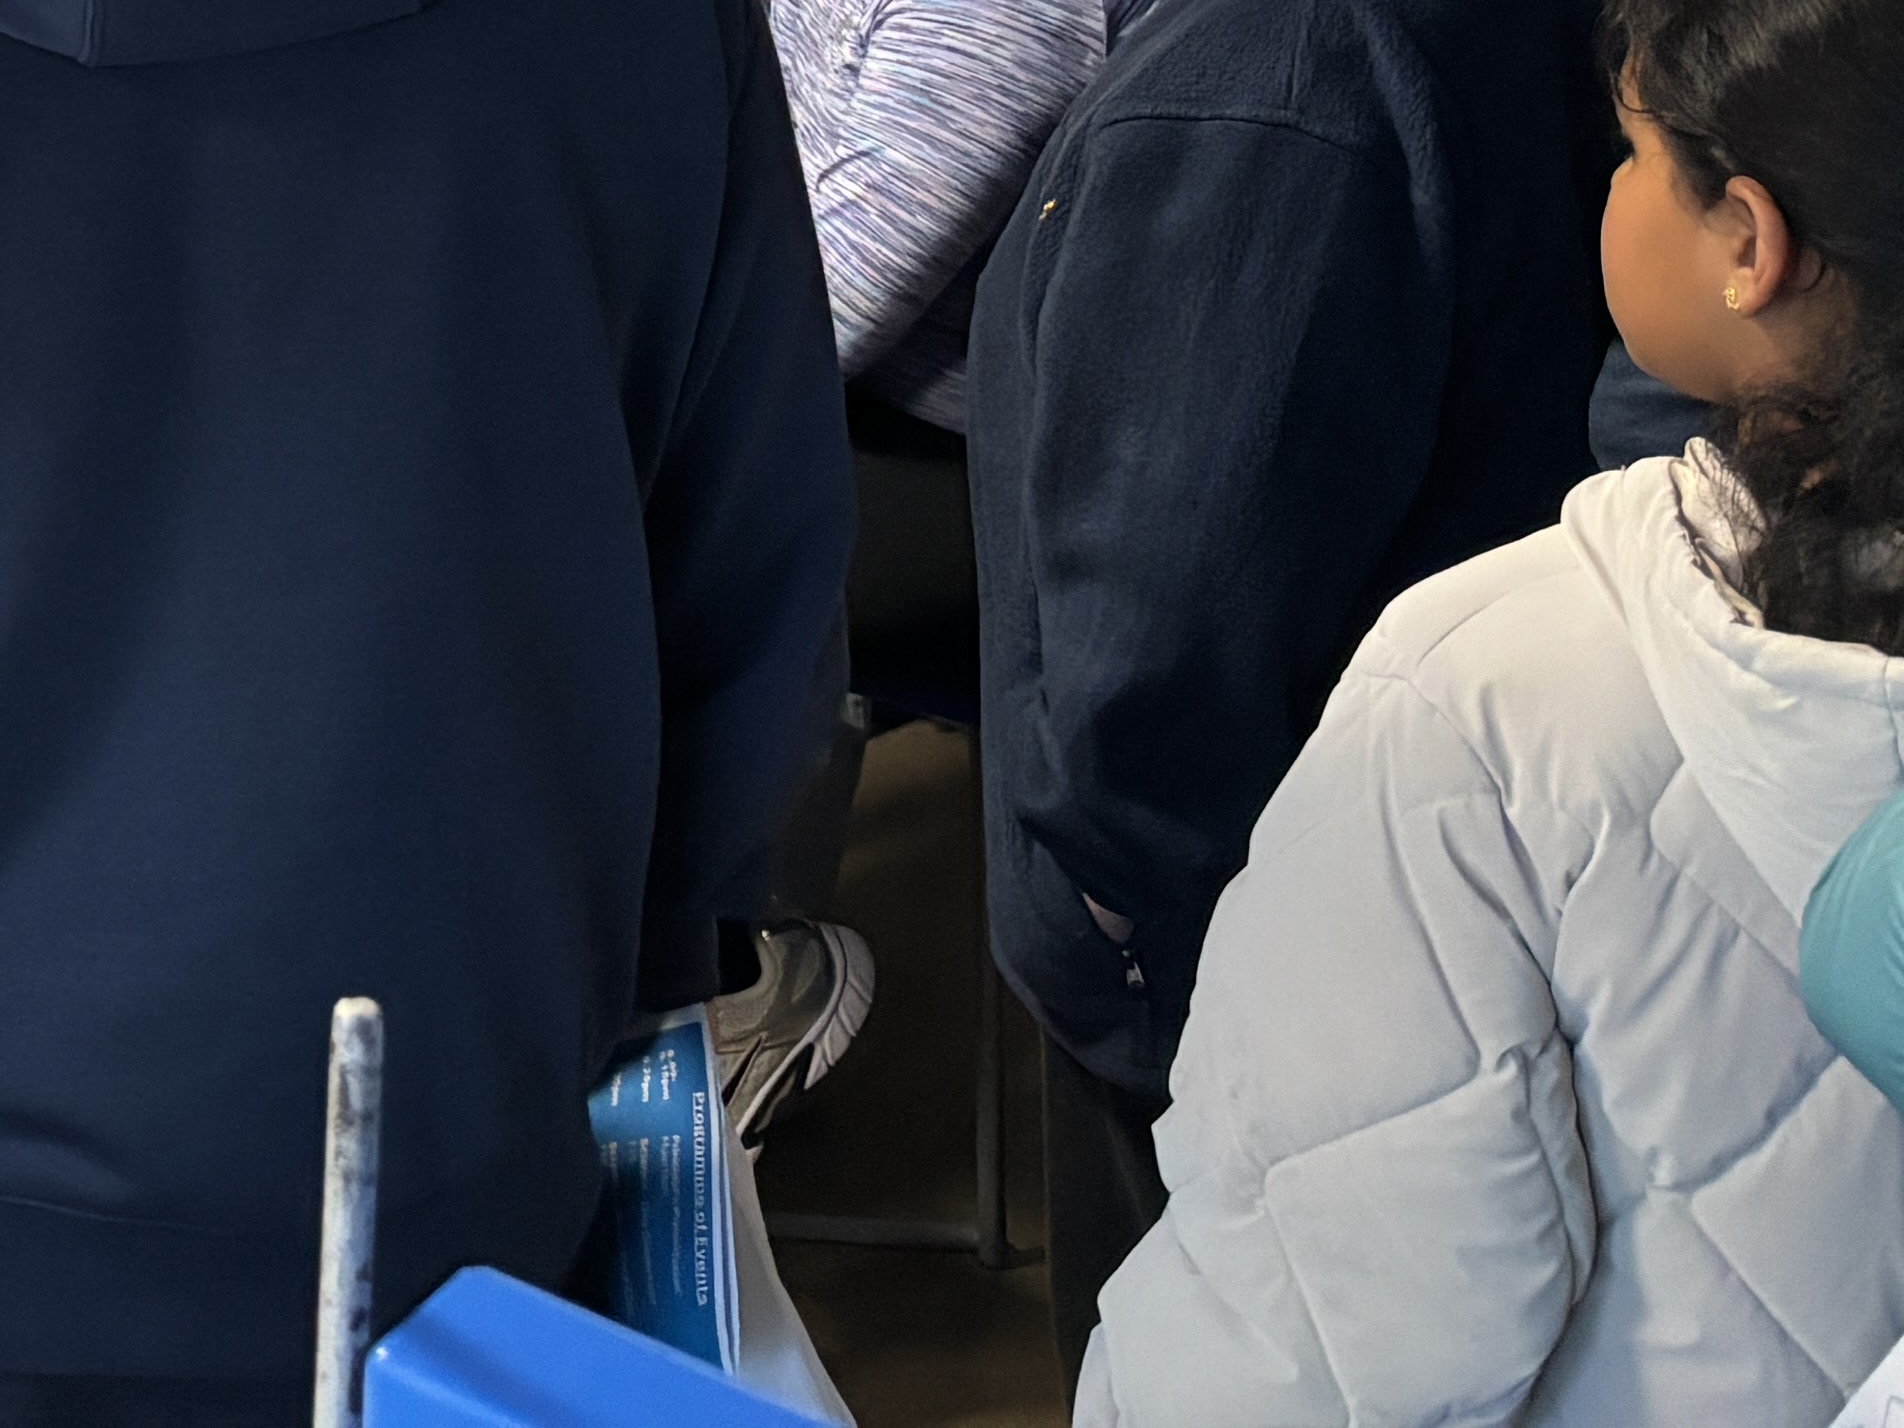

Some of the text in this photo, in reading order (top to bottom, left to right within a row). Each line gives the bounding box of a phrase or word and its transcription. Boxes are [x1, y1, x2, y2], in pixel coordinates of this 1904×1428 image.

[692, 1091, 709, 1307] Programme of Events
